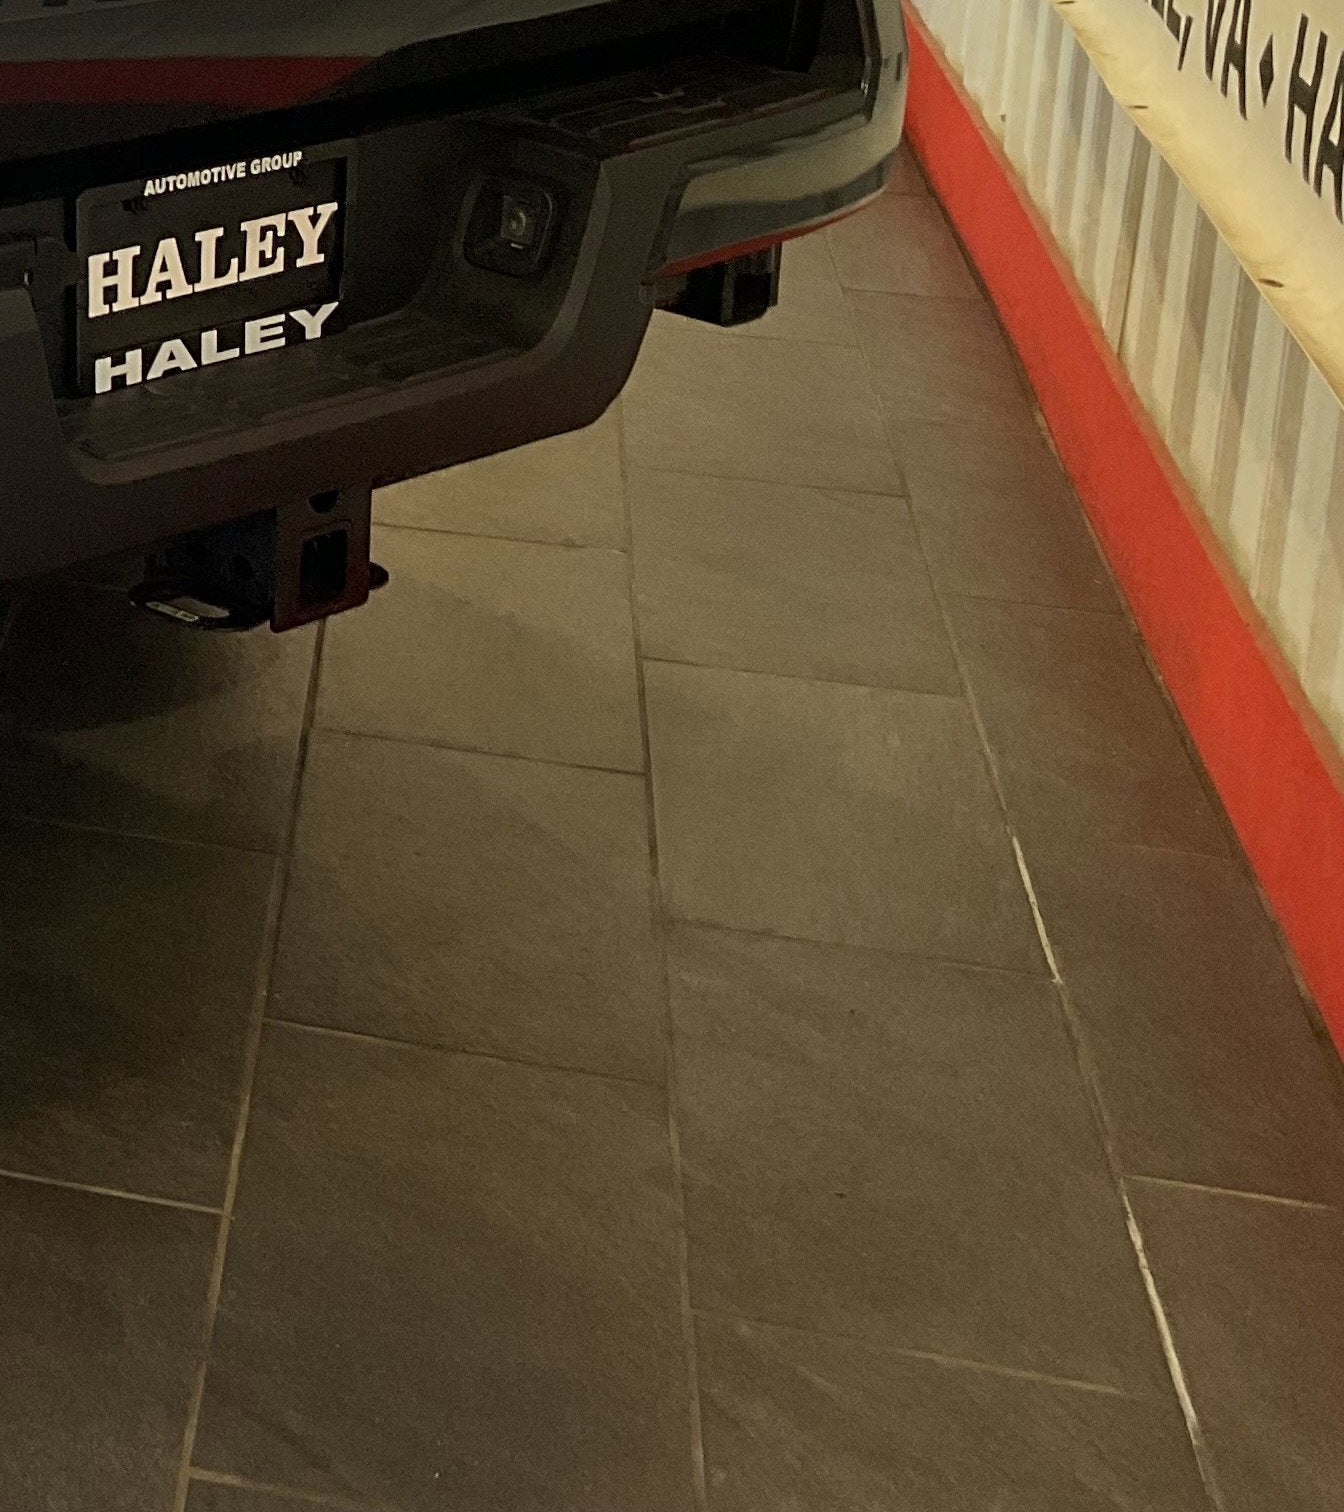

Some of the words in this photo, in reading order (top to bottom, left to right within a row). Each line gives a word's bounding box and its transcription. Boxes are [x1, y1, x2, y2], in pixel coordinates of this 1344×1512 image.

[143, 160, 247, 197] AUTOMOTIVE
[250, 149, 303, 176] GROUP
[86, 201, 339, 319] HALEY
[93, 300, 340, 395] HALEY
